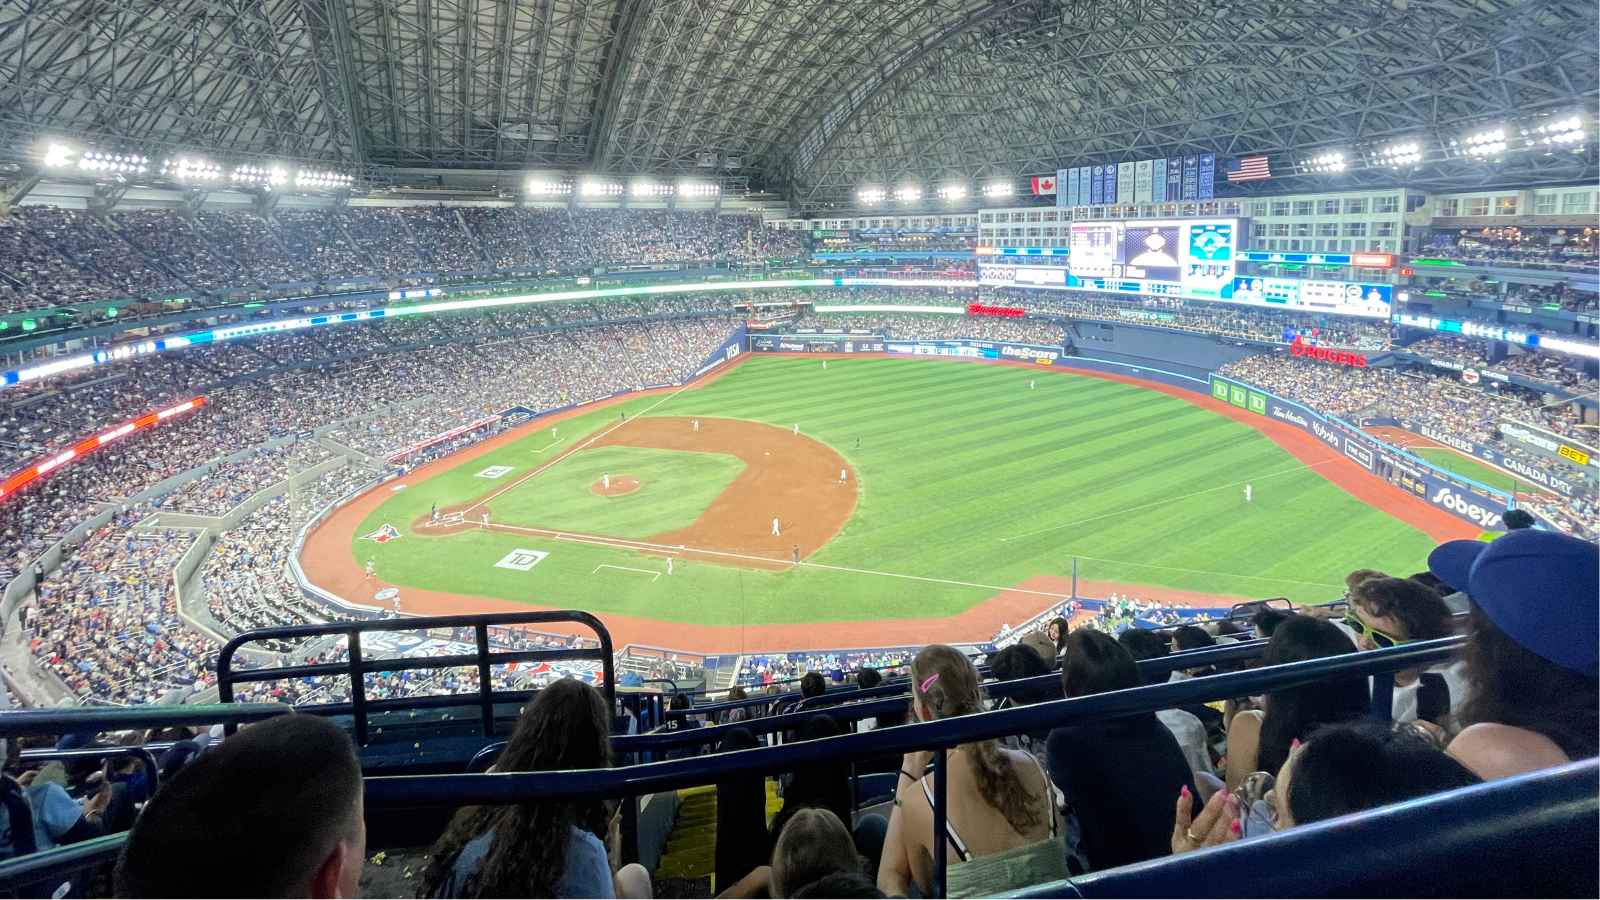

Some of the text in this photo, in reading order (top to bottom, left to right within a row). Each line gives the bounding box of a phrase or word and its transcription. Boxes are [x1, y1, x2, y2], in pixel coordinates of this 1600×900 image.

[725, 343, 741, 360] VISA
[1001, 345, 1058, 360] theScore
[1305, 346, 1367, 369] ROGERS
[1232, 390, 1244, 403] TD
[1250, 395, 1264, 409] TD
[1312, 421, 1339, 449] Kubota
[1420, 426, 1474, 453] BLEACHERS
[1560, 446, 1586, 463] BET
[1503, 457, 1573, 496] CANADA DRY
[1432, 487, 1502, 527] Sobeys
[510, 552, 540, 566] TD
[666, 719, 678, 730] 15
